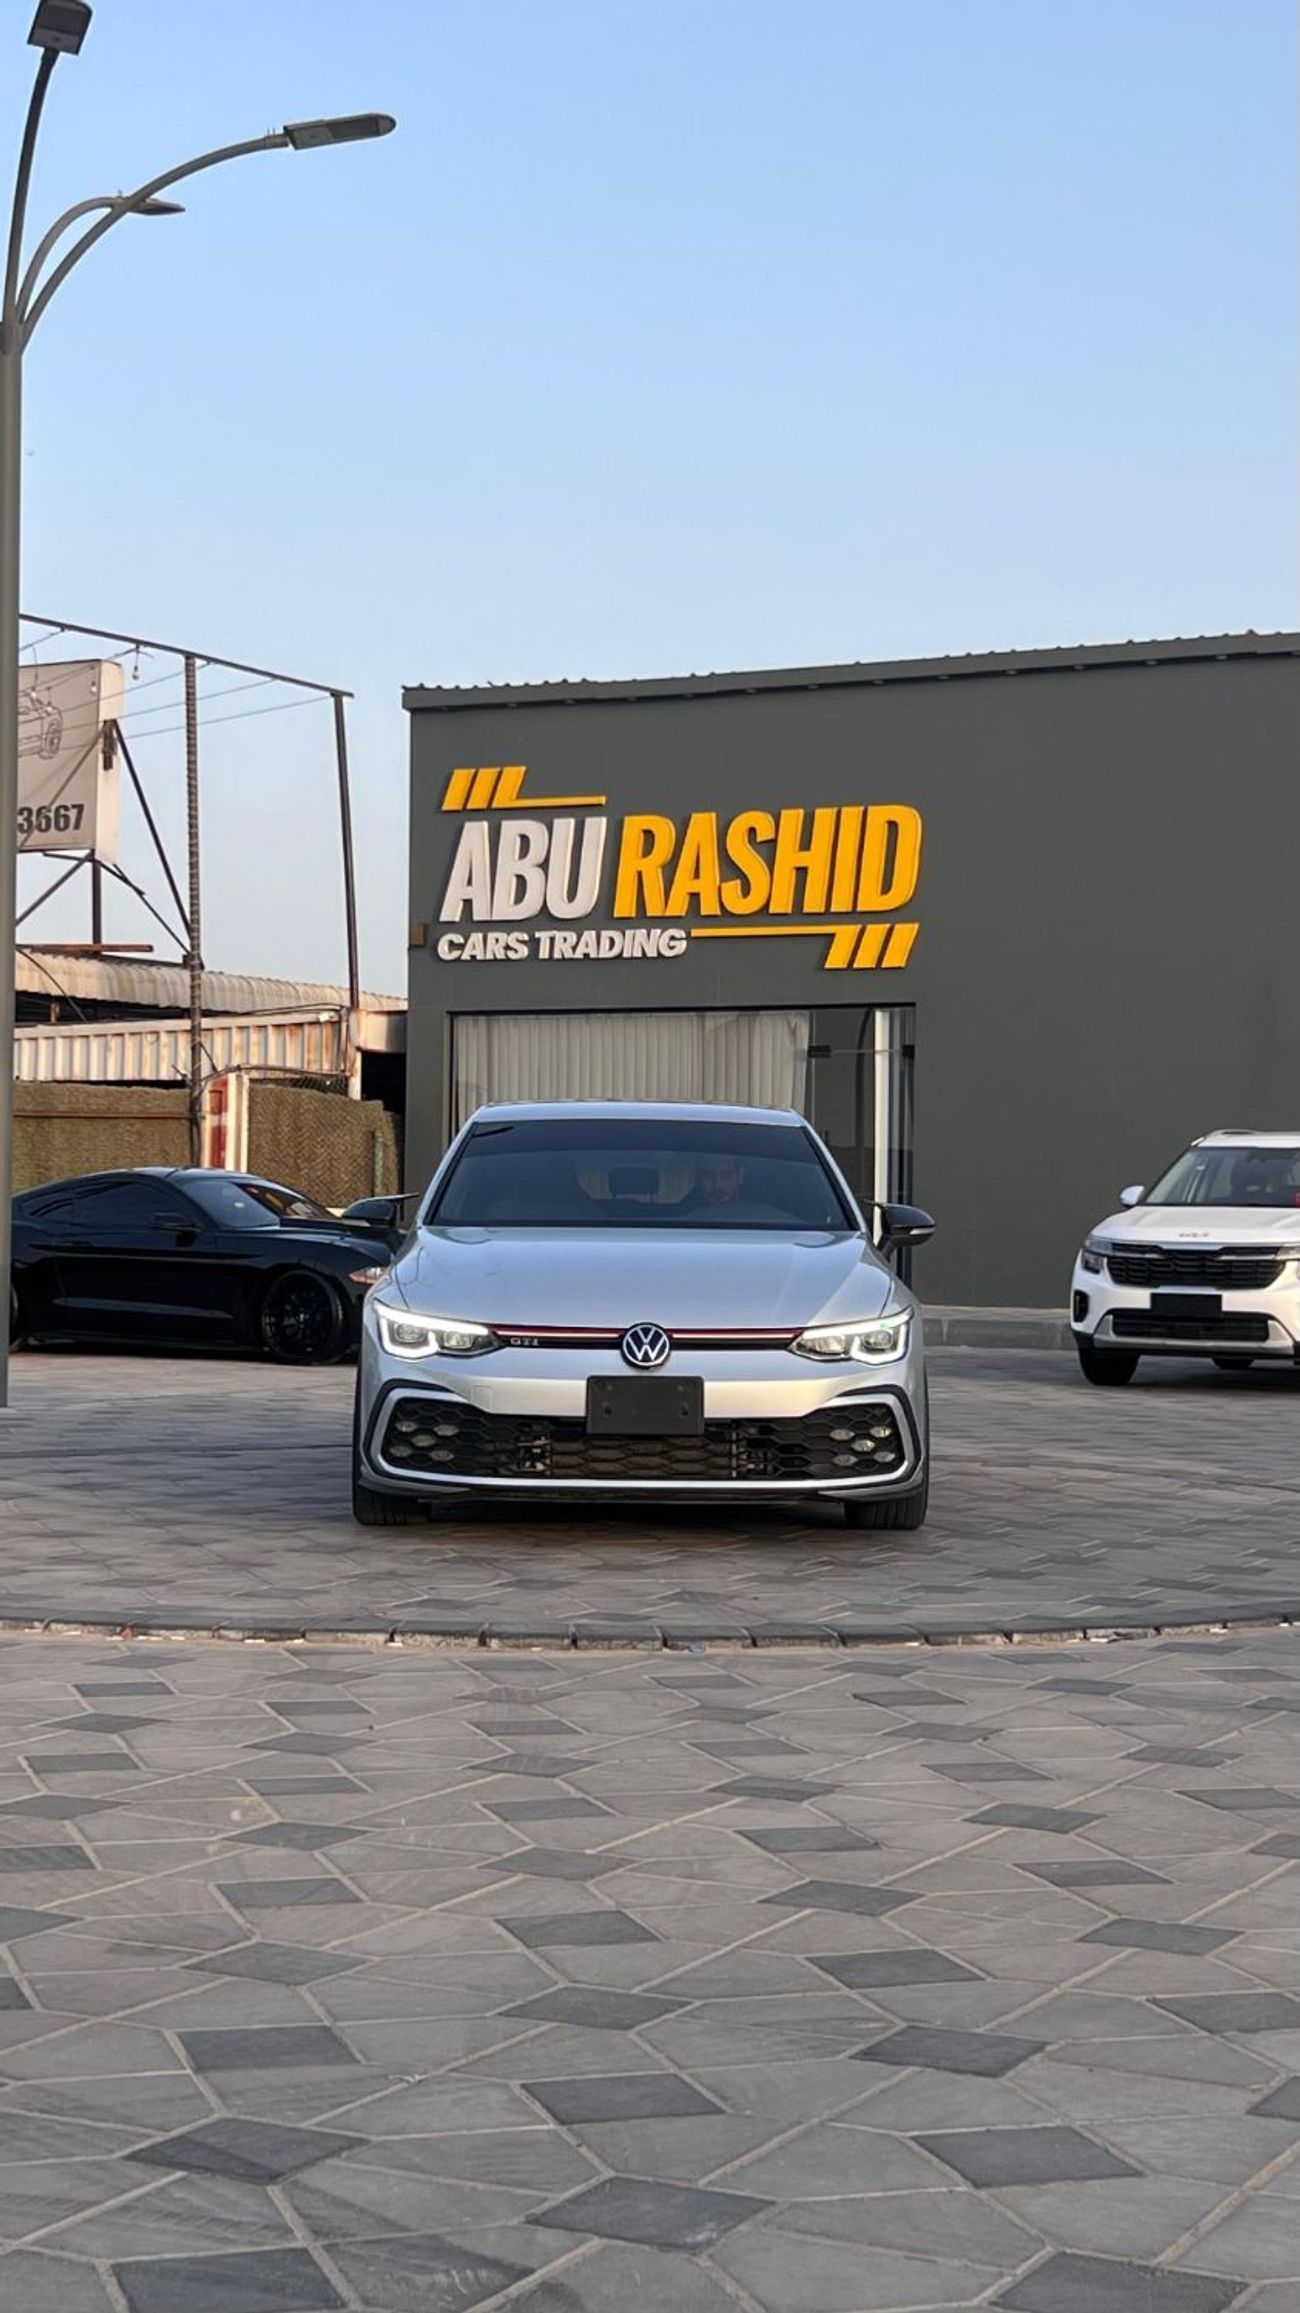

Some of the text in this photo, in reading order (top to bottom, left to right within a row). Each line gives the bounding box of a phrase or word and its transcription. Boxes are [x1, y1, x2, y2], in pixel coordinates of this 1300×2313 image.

[439, 805, 923, 922] ABU RASHID
[437, 928, 687, 960] CARS TRADING
